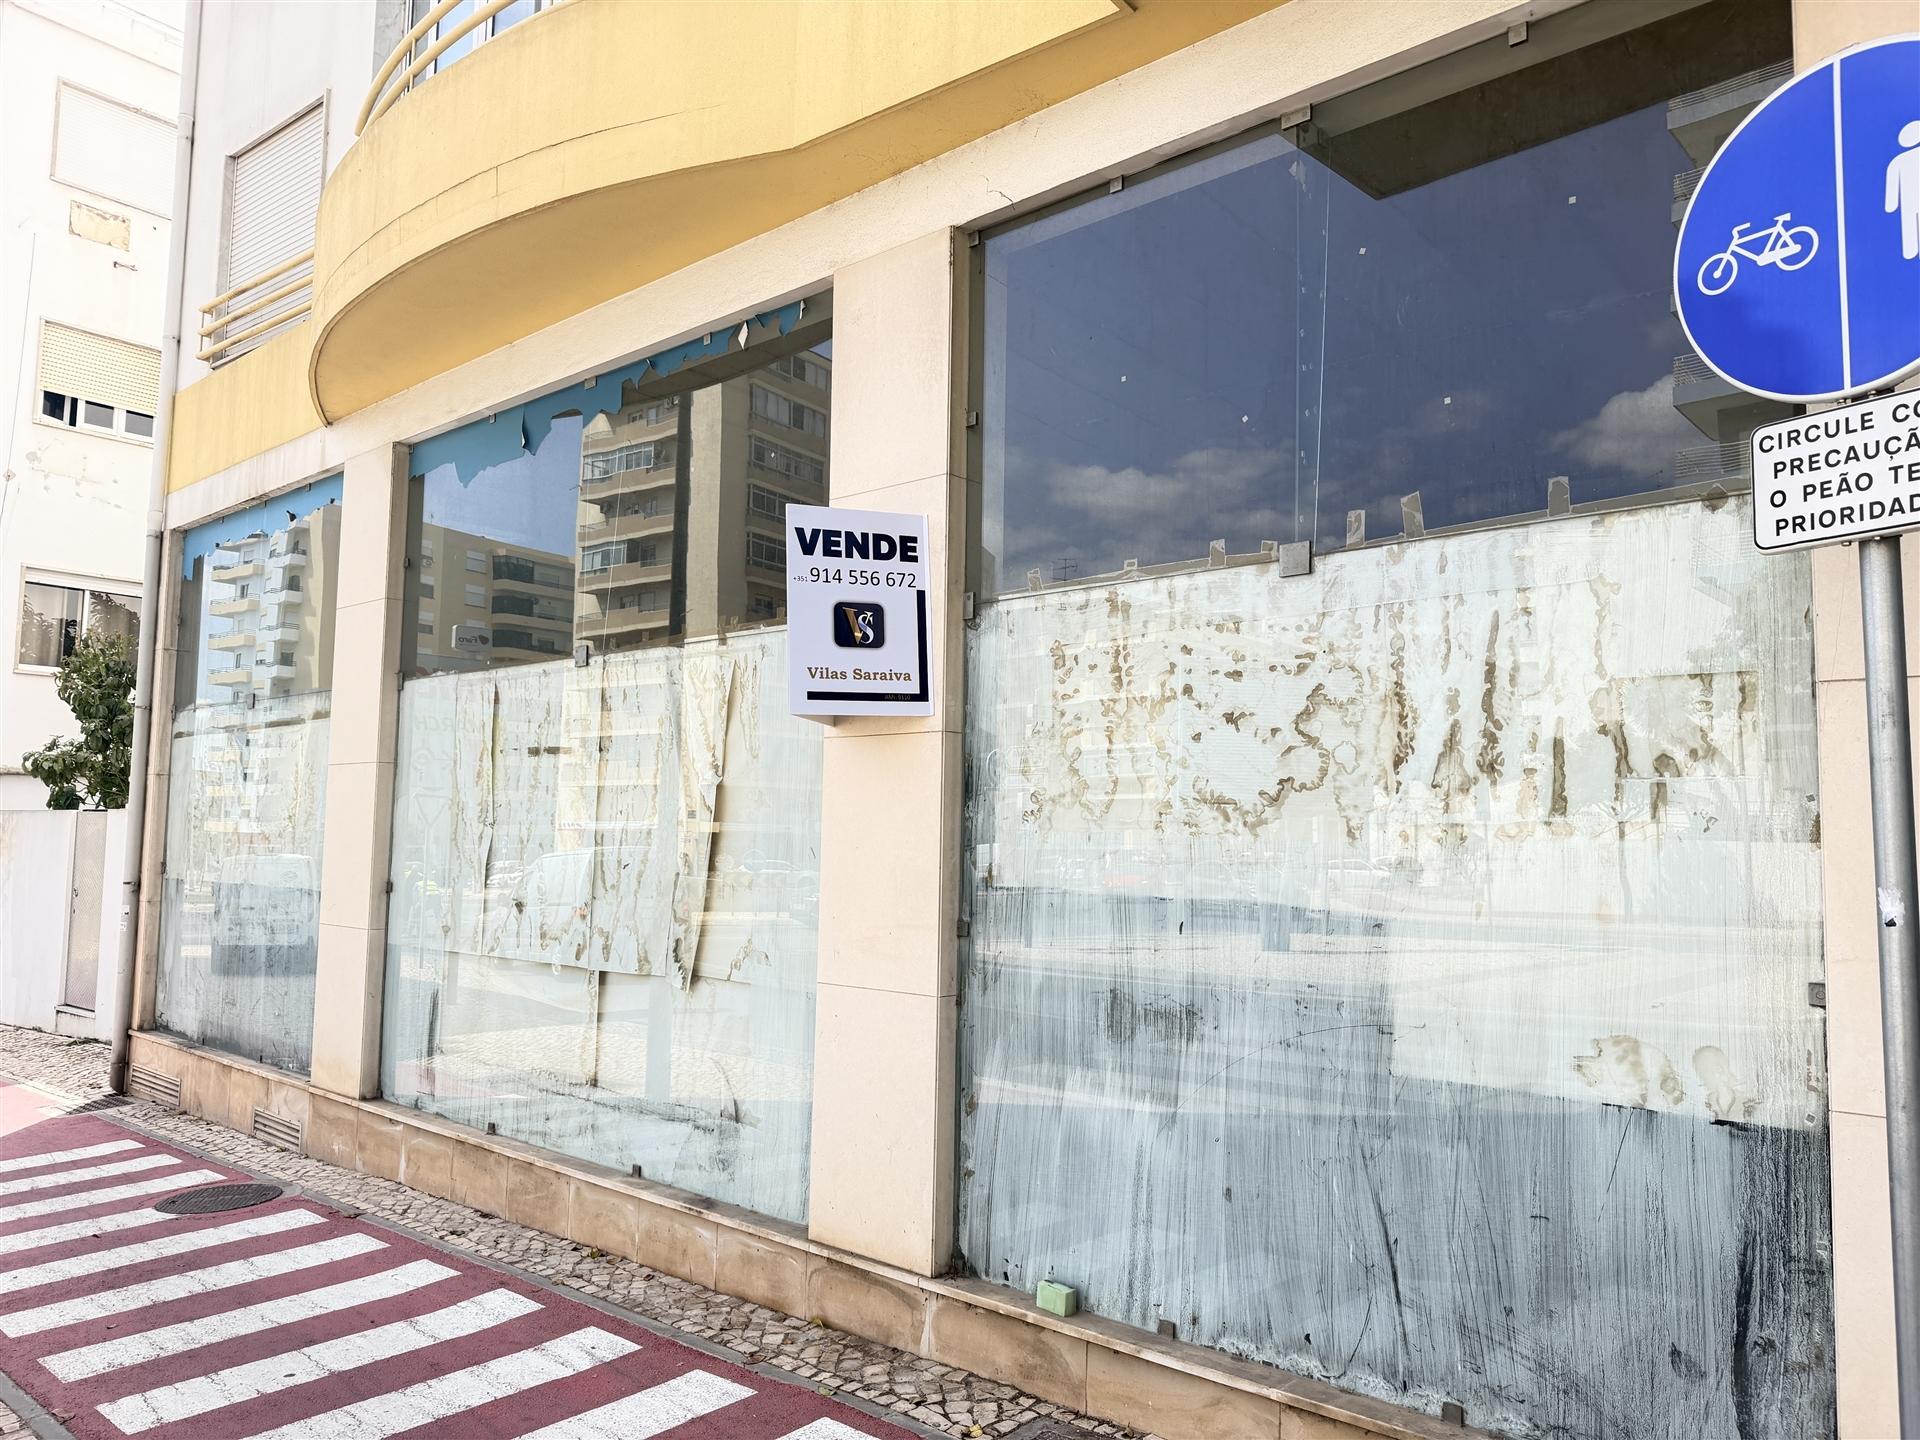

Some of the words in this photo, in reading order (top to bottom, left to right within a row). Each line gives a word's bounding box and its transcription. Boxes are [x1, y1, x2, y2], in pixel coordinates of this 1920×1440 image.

[1759, 411, 1875, 453] CIRCULE
[1770, 490, 1787, 508] O
[1803, 472, 1874, 502] PEÃO
[794, 526, 919, 563] VENDE
[793, 575, 808, 583] +351
[810, 567, 843, 584] 914
[849, 569, 881, 586] 556
[886, 572, 917, 588] 672
[807, 666, 848, 681] Vilas
[853, 668, 912, 682] Saraiva
